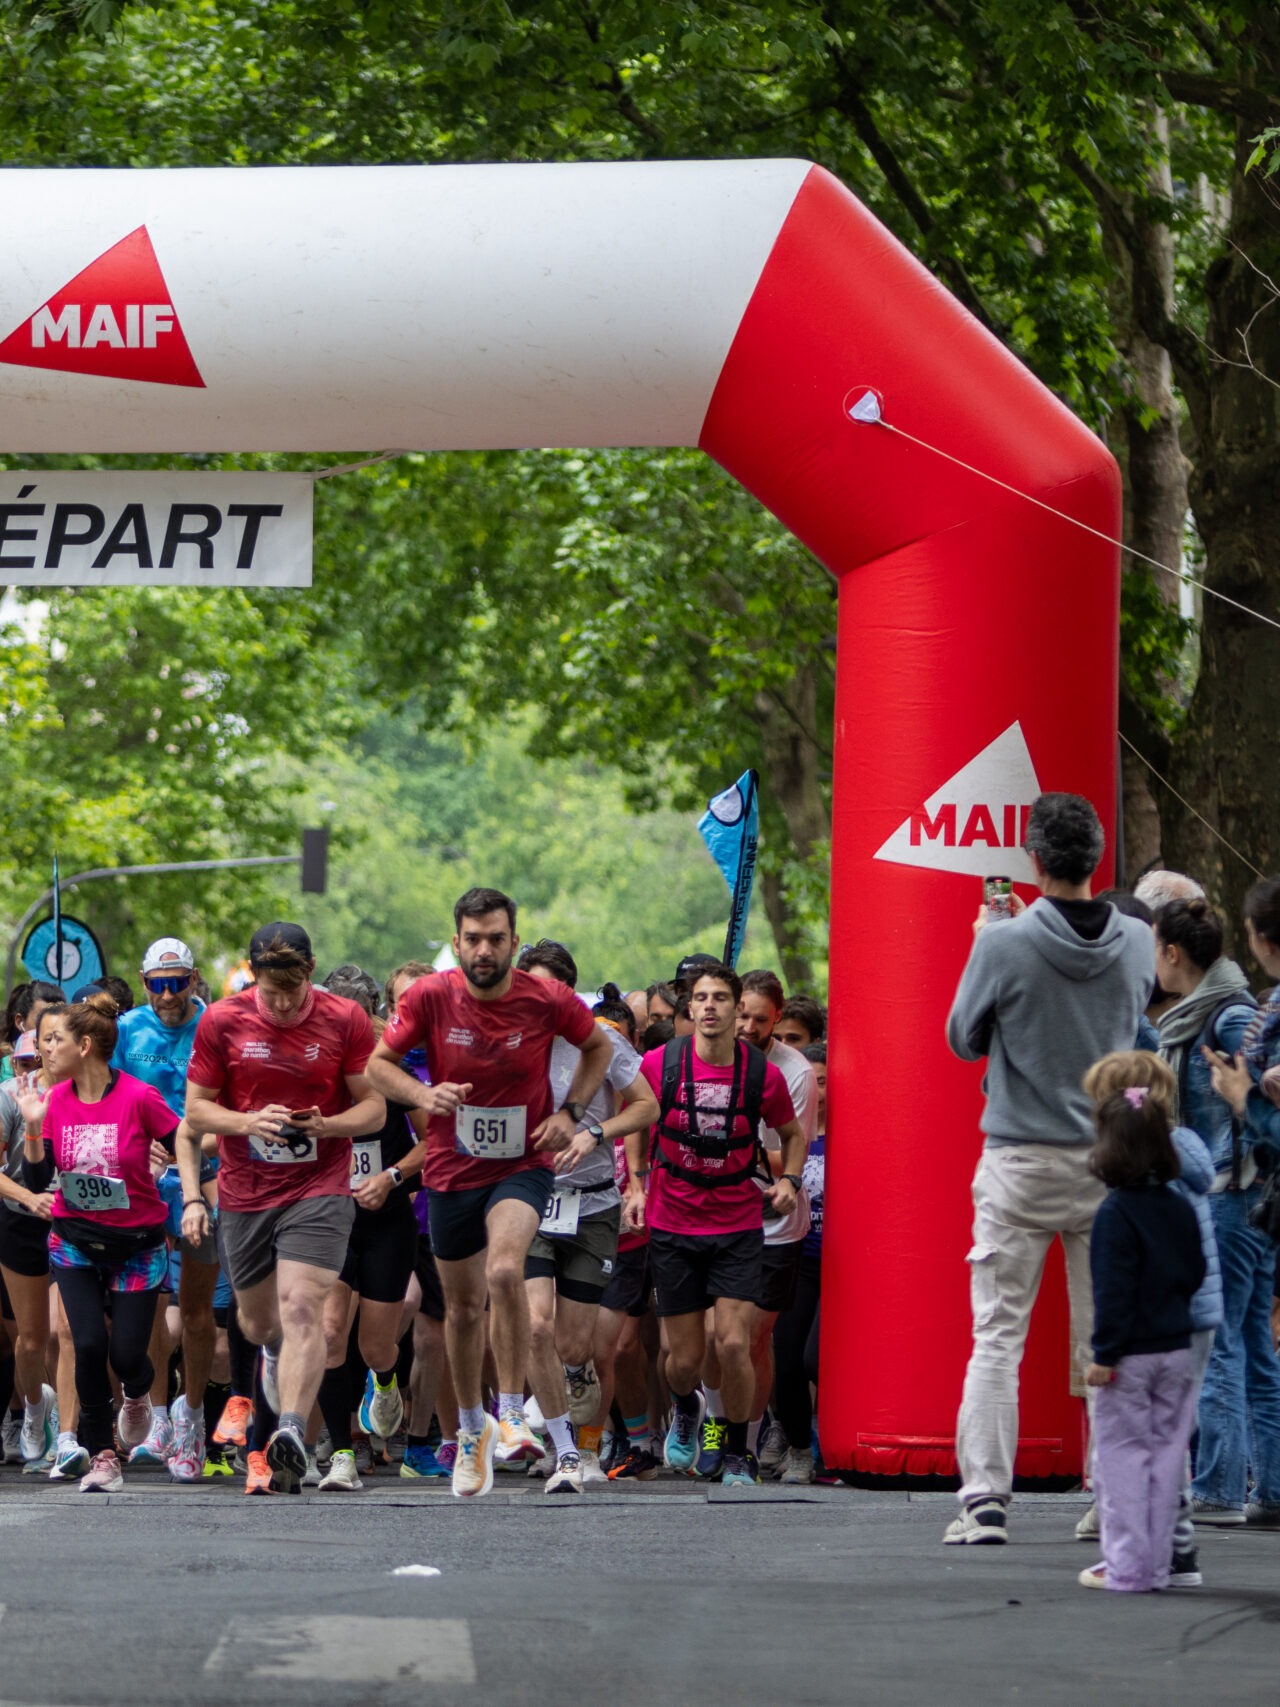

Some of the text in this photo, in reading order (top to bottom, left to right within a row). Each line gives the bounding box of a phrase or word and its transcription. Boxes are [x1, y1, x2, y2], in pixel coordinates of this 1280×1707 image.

[31, 304, 173, 349] MAIF
[144, 1054, 168, 1064] 2025
[473, 1118, 507, 1144] 651
[75, 1177, 113, 1199] 398
